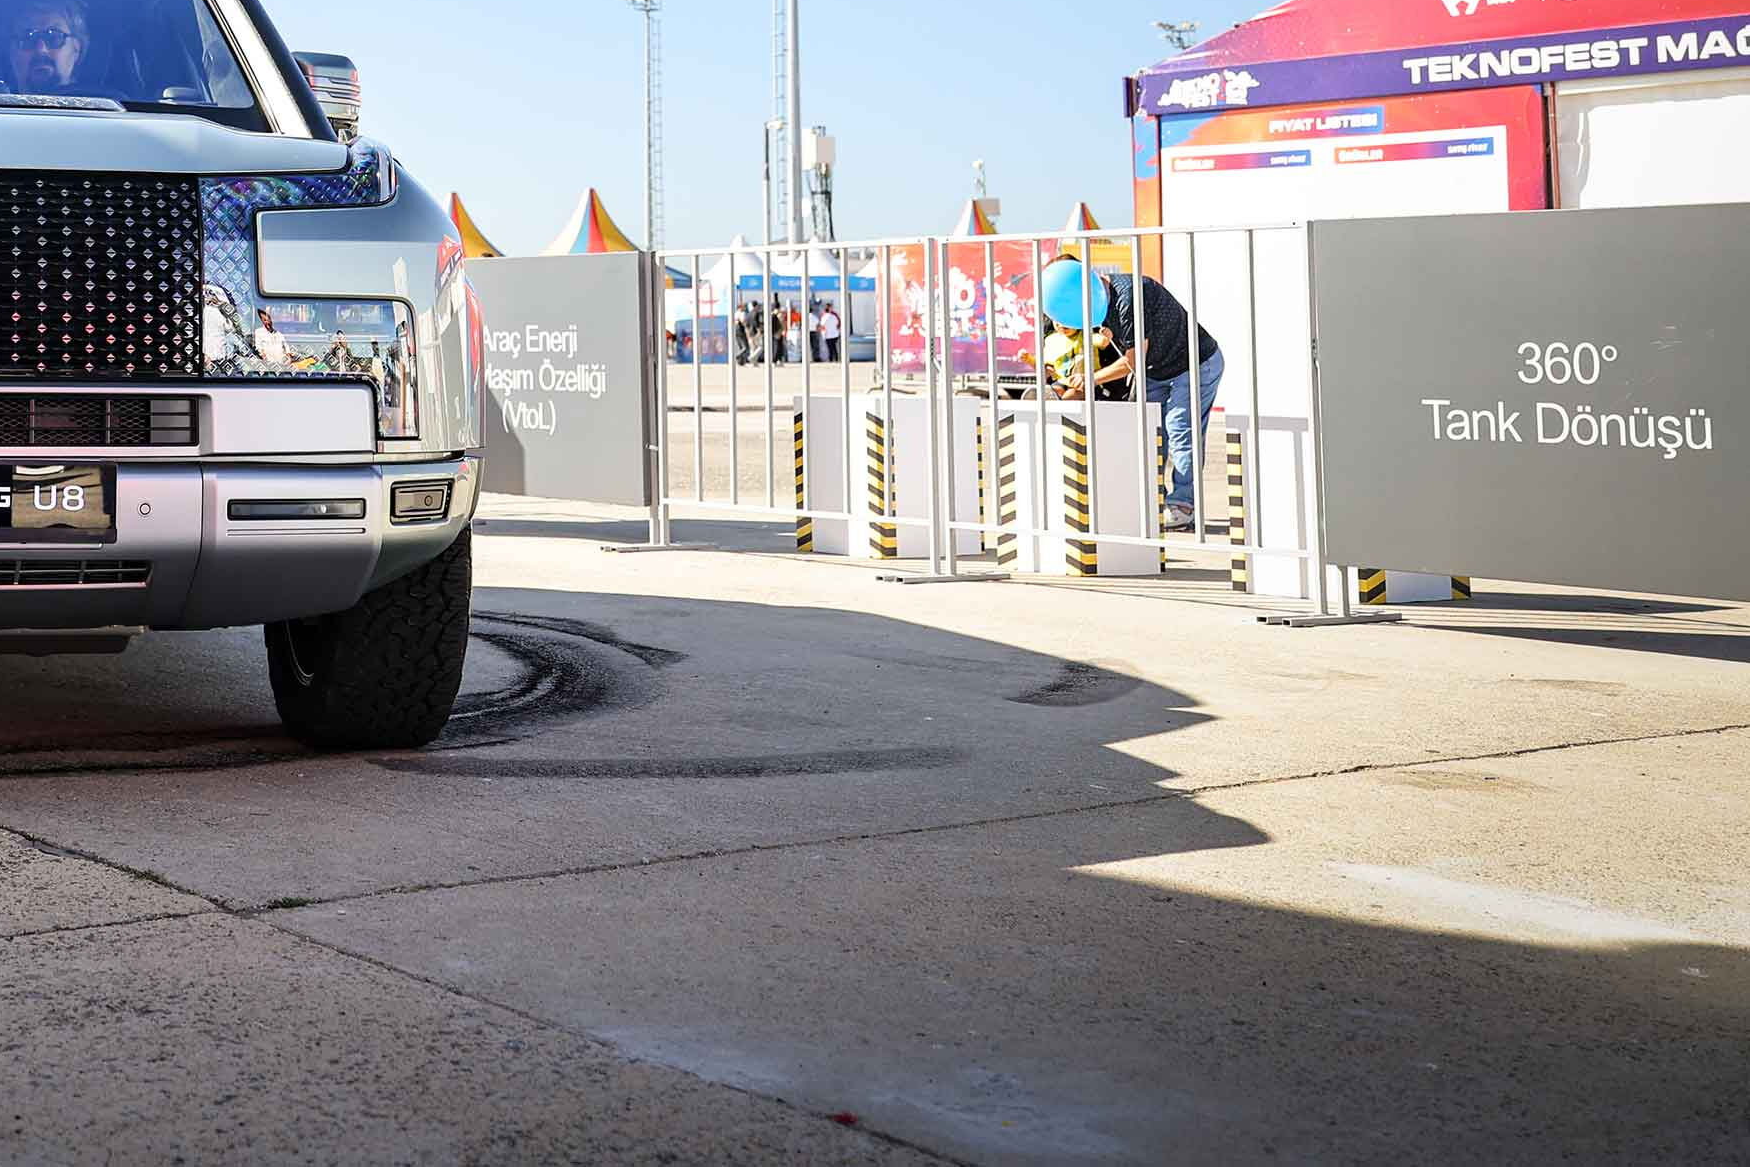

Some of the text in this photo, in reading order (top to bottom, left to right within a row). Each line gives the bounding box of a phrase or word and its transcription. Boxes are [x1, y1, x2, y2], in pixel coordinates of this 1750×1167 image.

[1403, 37, 1648, 84] TEKNOFEST
[525, 324, 578, 359] Enerji
[538, 359, 607, 399] Özelliği
[1517, 341, 1618, 384] 360°
[502, 399, 556, 435] (VtoL)
[1421, 399, 1714, 459] Tank Dönüşü
[33, 484, 85, 511] U8
